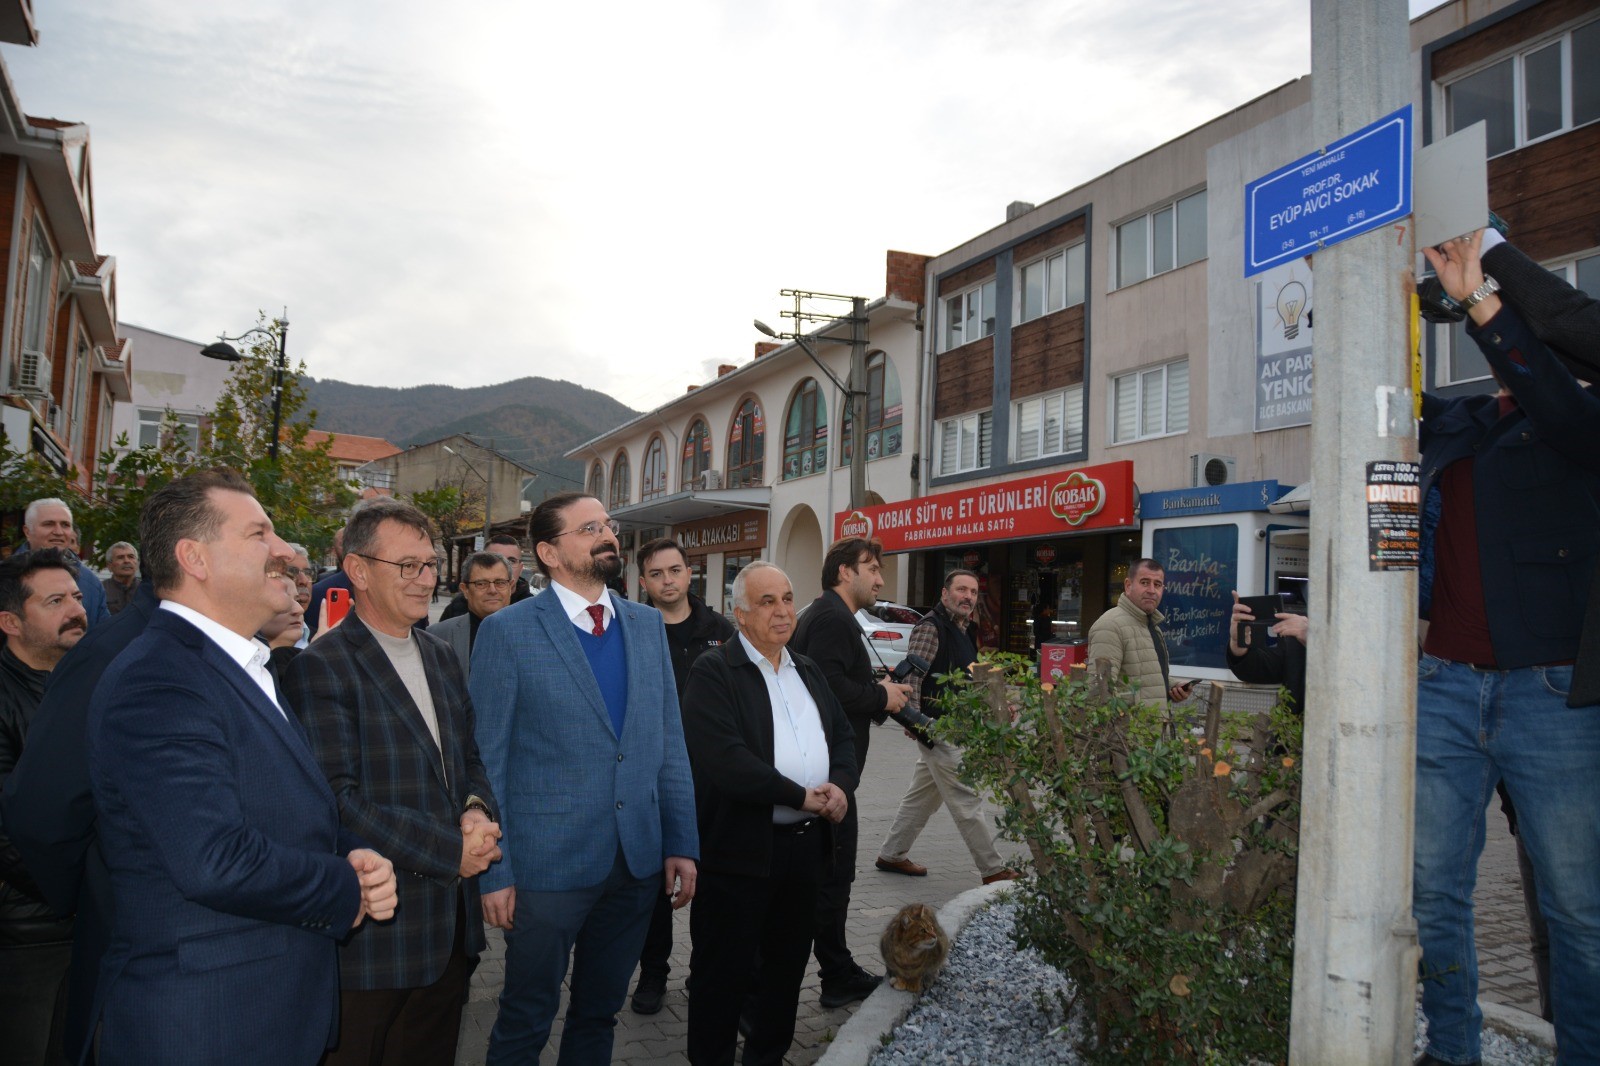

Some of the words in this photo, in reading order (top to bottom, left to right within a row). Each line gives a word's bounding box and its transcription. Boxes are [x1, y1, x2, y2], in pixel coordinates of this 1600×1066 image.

[1317, 151, 1345, 171] MAHALLE
[1303, 173, 1343, 198] PROF.DR.
[1270, 205, 1302, 230] EYÜP
[1303, 191, 1331, 216] AVCI
[1334, 169, 1379, 202] SOKAK
[1261, 360, 1282, 379] AK
[1286, 354, 1313, 374] PAR
[1393, 472, 1415, 482] 1000
[1395, 462, 1411, 472] 100
[878, 508, 912, 530] KOBAK
[916, 501, 938, 524] SÜT
[941, 506, 953, 520] ve
[959, 498, 974, 518] ET
[979, 480, 1047, 515] ÜRÜNLERİ
[1055, 486, 1096, 507] KOBAK
[1163, 493, 1221, 510] Bankamatik
[702, 523, 740, 547] AYAKKABI
[843, 523, 867, 537] KOBAK
[956, 521, 984, 535] HALKA
[987, 517, 1015, 532] SATIŞ
[1168, 548, 1227, 575] Banka-
[1167, 577, 1221, 600] matik.
